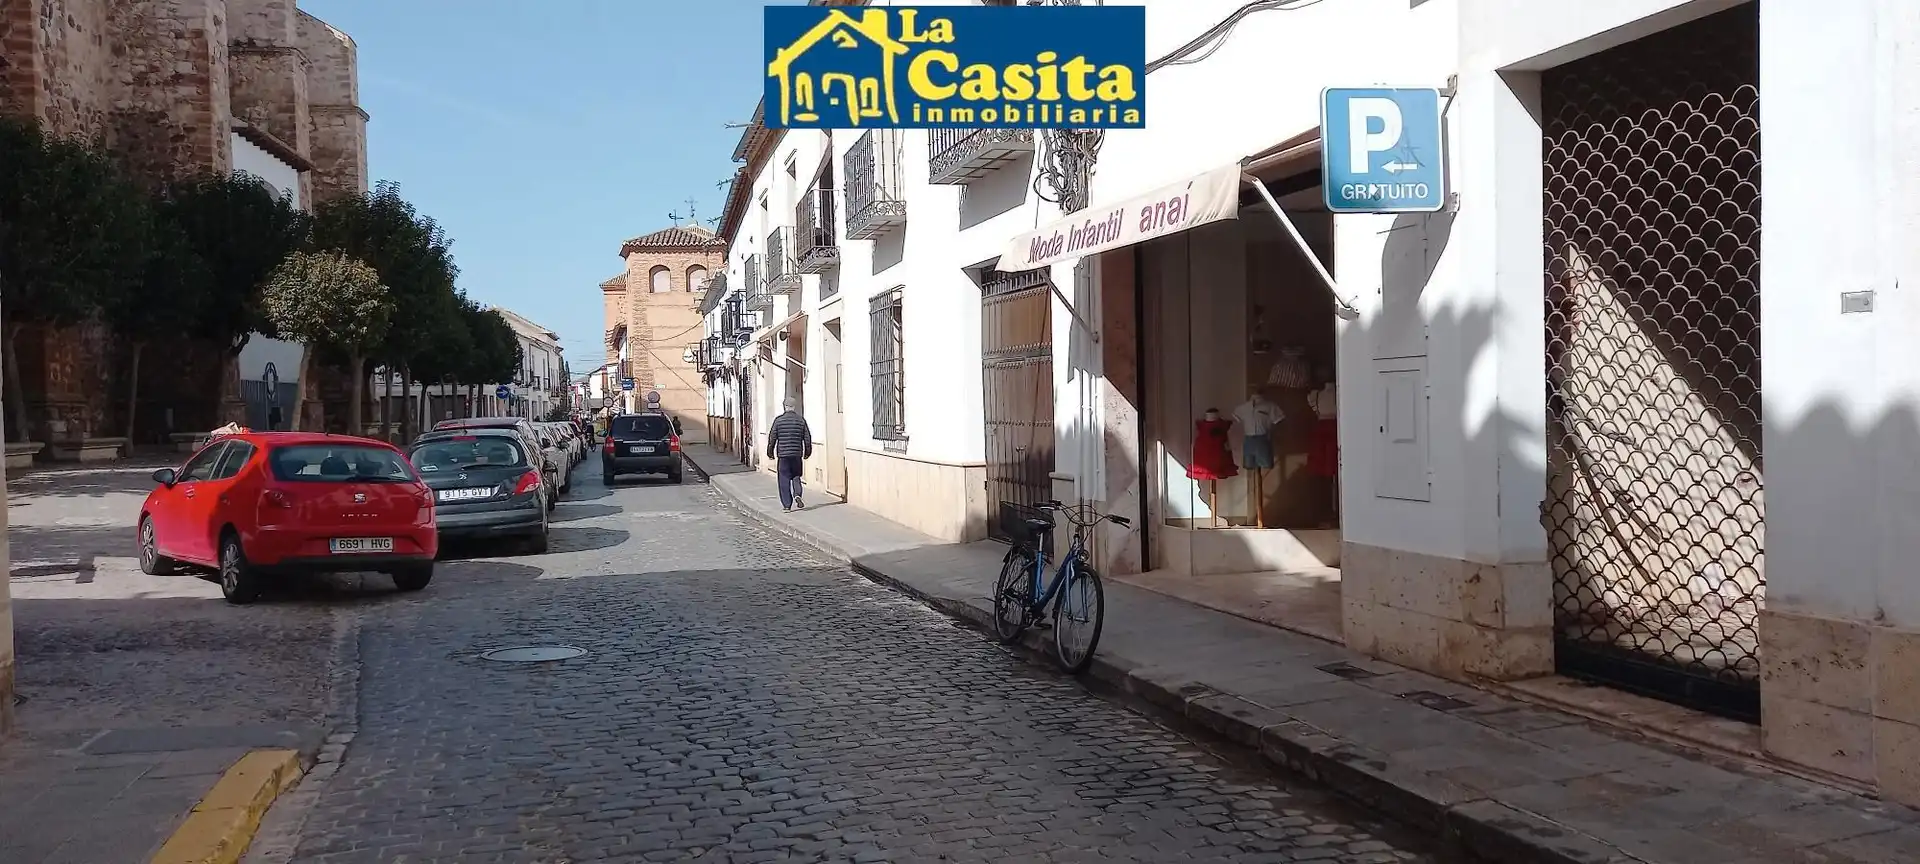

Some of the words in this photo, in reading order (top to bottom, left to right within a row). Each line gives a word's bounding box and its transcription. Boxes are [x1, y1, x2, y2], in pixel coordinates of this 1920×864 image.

[1348, 97, 1404, 174] P
[1341, 183, 1429, 200] GRATUITO
[1027, 230, 1064, 263] Moda
[1067, 208, 1124, 252] Infantil
[1139, 181, 1193, 233] anaí
[445, 488, 468, 498] 9115
[339, 539, 364, 549] 6691
[371, 539, 390, 548] HVG
